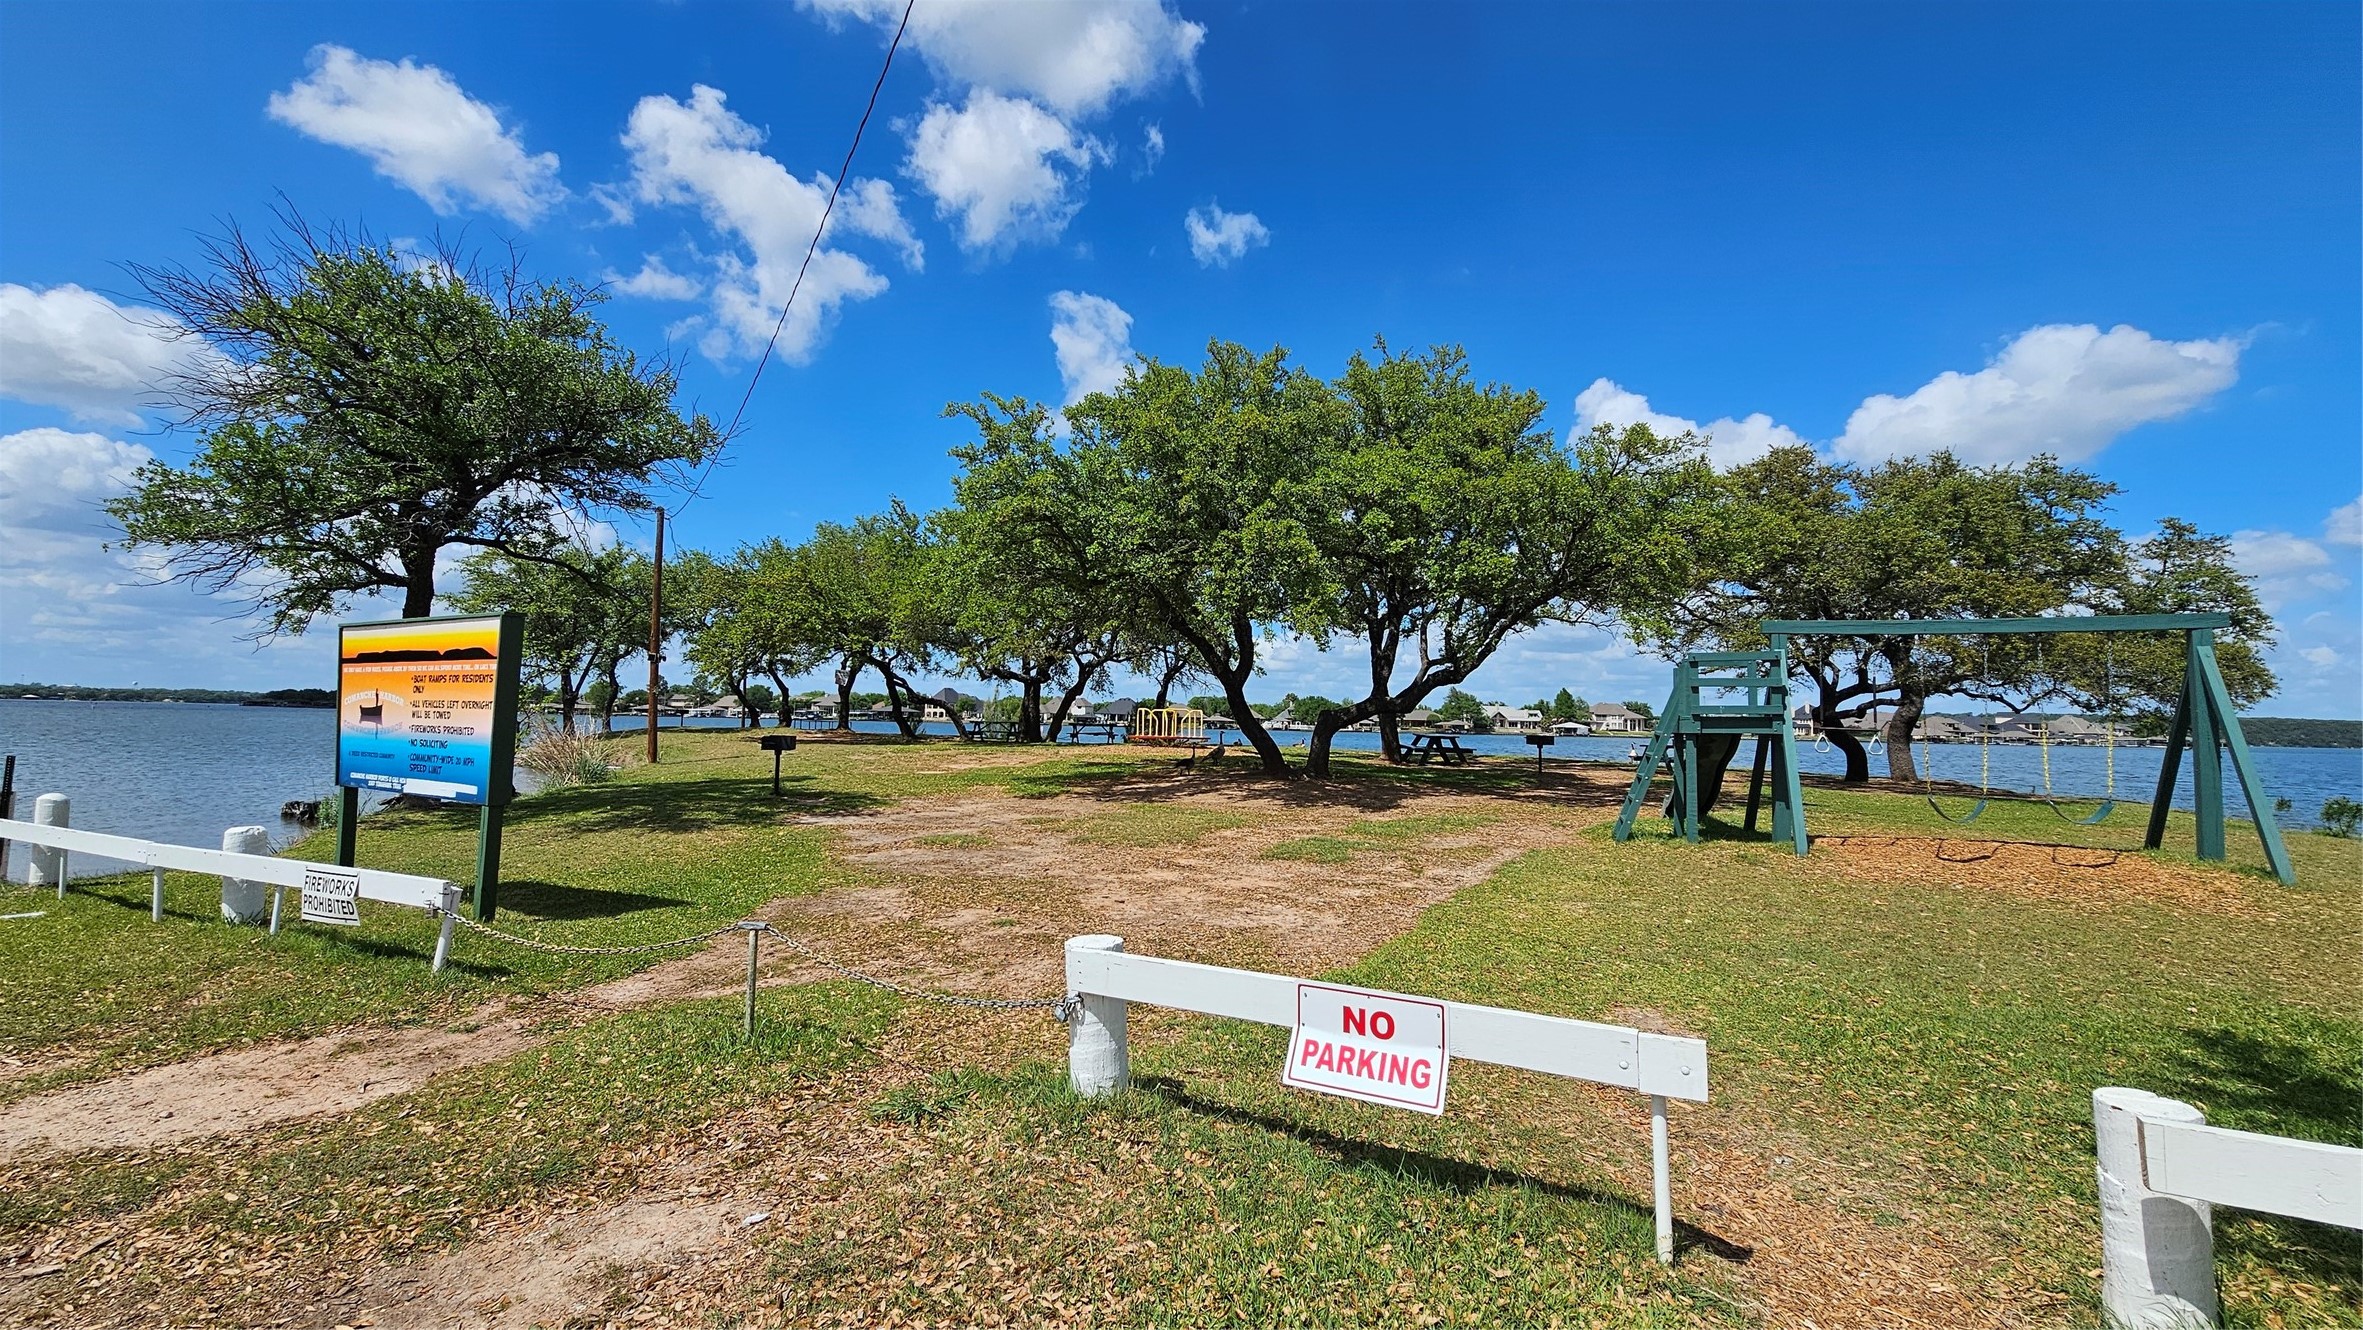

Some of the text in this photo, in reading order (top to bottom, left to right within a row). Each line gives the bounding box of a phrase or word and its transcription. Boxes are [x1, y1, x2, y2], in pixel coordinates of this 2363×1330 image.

[413, 674, 494, 684] BOAT RAMPS FOR RESIDENTS
[413, 685, 424, 693] ONLY
[412, 700, 493, 710] ALL VEHICLES LEFT OVERNIGHT
[412, 710, 452, 720] WILL BE TOWED
[411, 724, 475, 736] FIREWORKS PROHIBITED
[410, 738, 448, 749] NO SOLICITING
[455, 757, 462, 766] 20
[463, 757, 475, 766] MPH
[409, 763, 427, 773] SPEED
[304, 875, 355, 897] FIREWORKS
[303, 894, 355, 915] PROHIBITED
[1342, 1005, 1395, 1040] NO
[1300, 1038, 1432, 1090] PARKING
